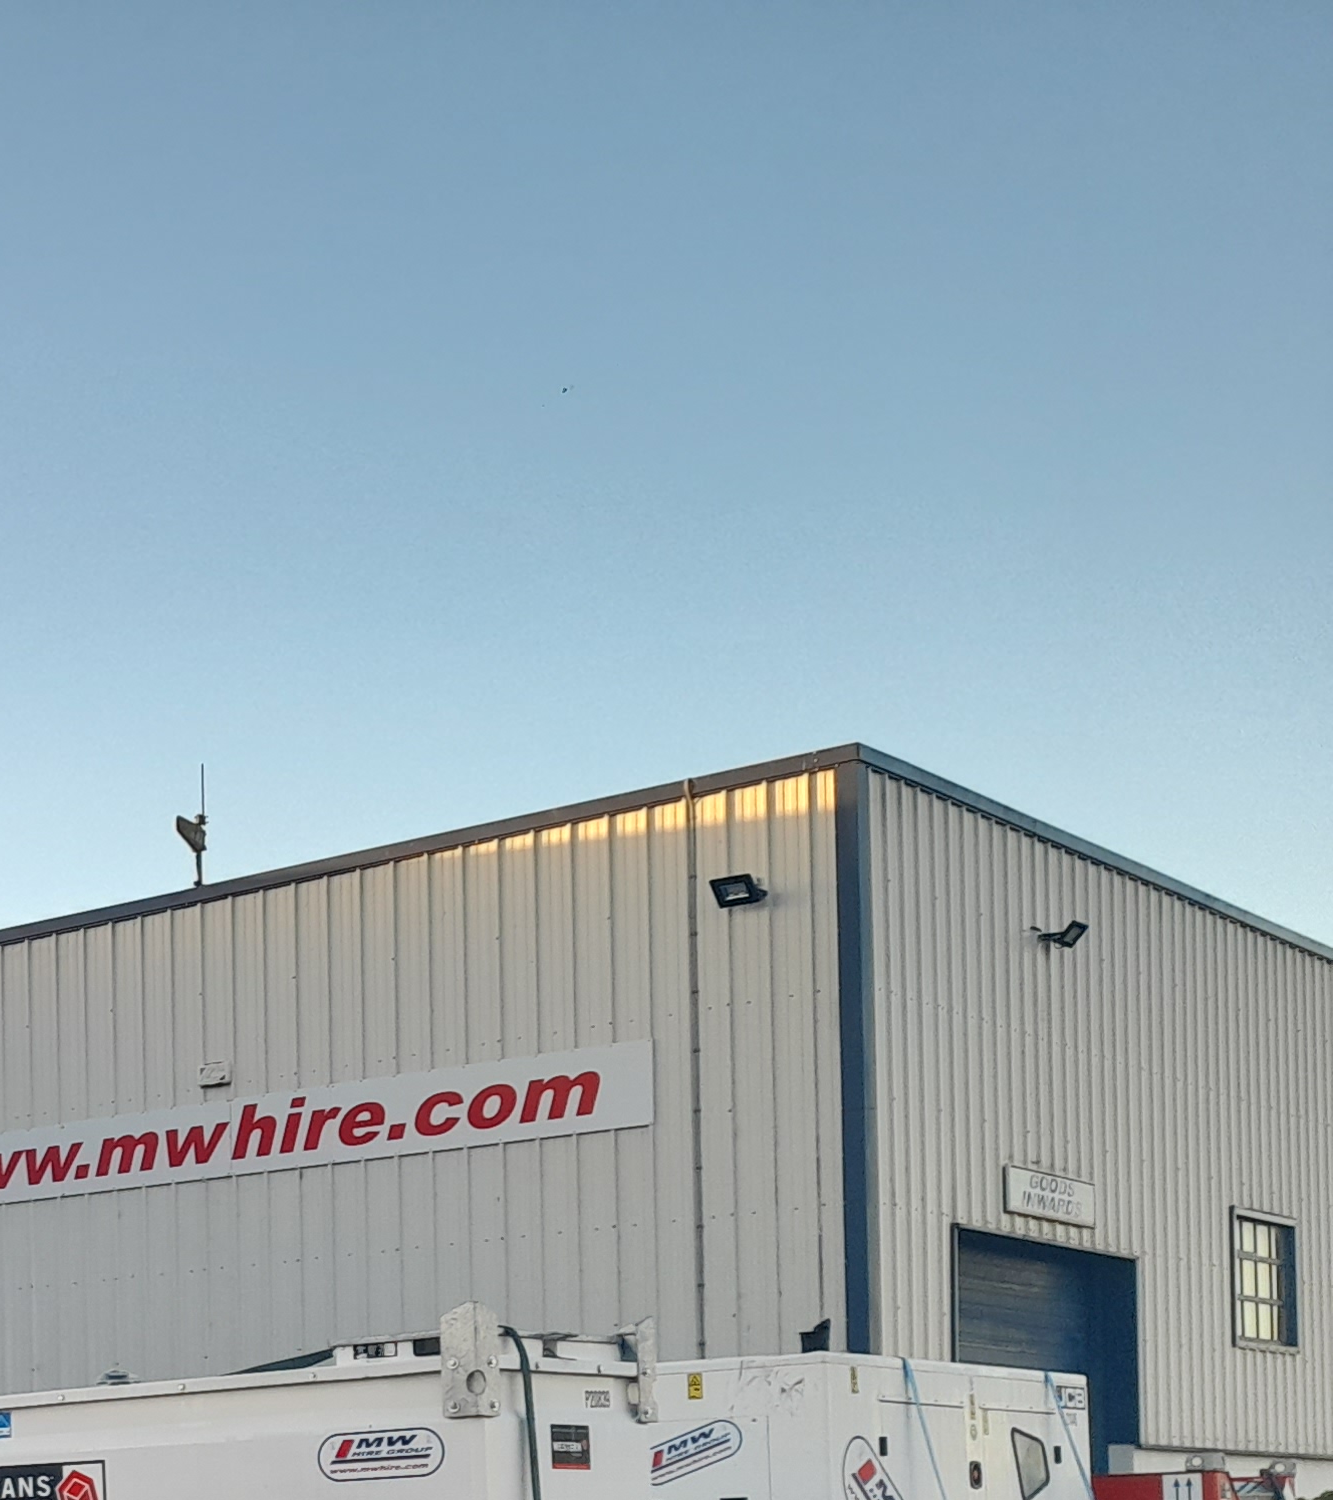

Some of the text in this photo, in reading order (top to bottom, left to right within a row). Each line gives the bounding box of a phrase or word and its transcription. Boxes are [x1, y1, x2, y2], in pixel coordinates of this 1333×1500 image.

[1029, 1174, 1075, 1198] GOODS
[1022, 1190, 1083, 1218] INWARDS
[351, 1446, 434, 1458] HIRE GROUP
[355, 1434, 418, 1450] MW
[667, 1427, 715, 1455] MW
